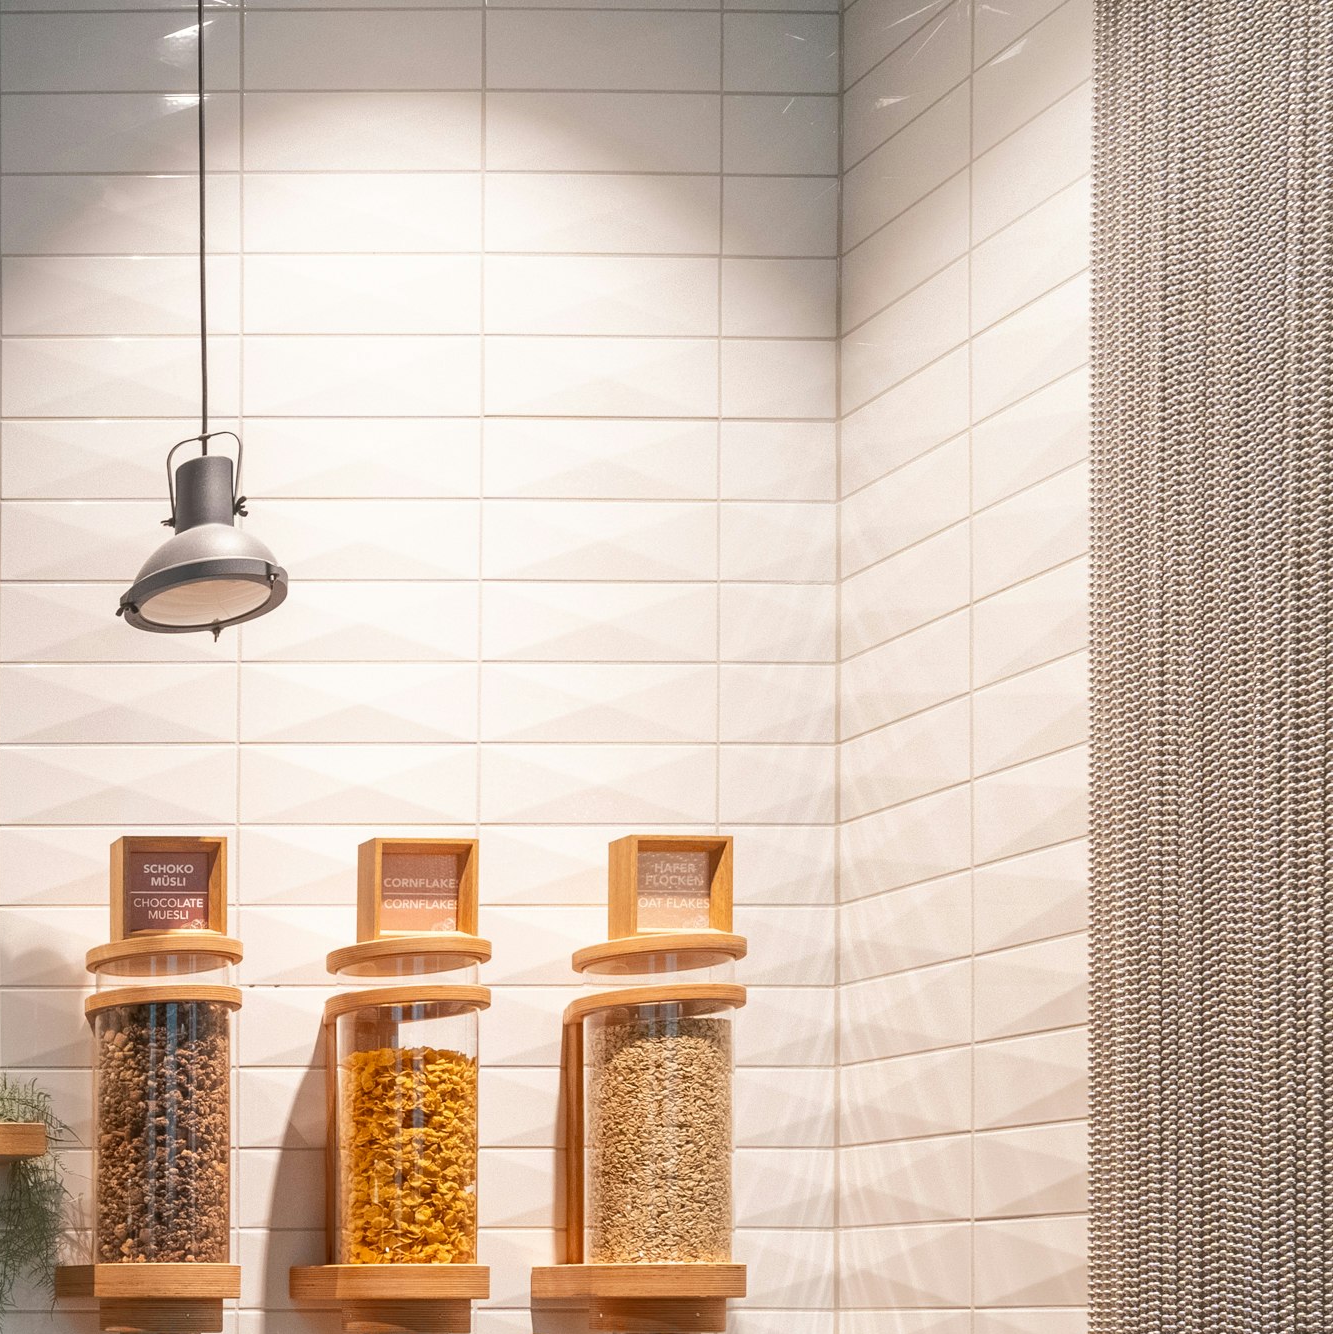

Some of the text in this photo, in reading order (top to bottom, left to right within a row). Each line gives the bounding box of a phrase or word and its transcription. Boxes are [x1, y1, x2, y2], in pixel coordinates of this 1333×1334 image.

[143, 864, 194, 874] SCHOKO
[654, 863, 695, 873] HAFER
[151, 875, 186, 886] MÜSLI
[383, 878, 458, 888] CORNFLAKE
[645, 873, 704, 886] FLOCKEN
[133, 898, 204, 908] CHOCOLATE
[637, 897, 710, 909] OAT FLAKES
[148, 910, 189, 920] MUESLI
